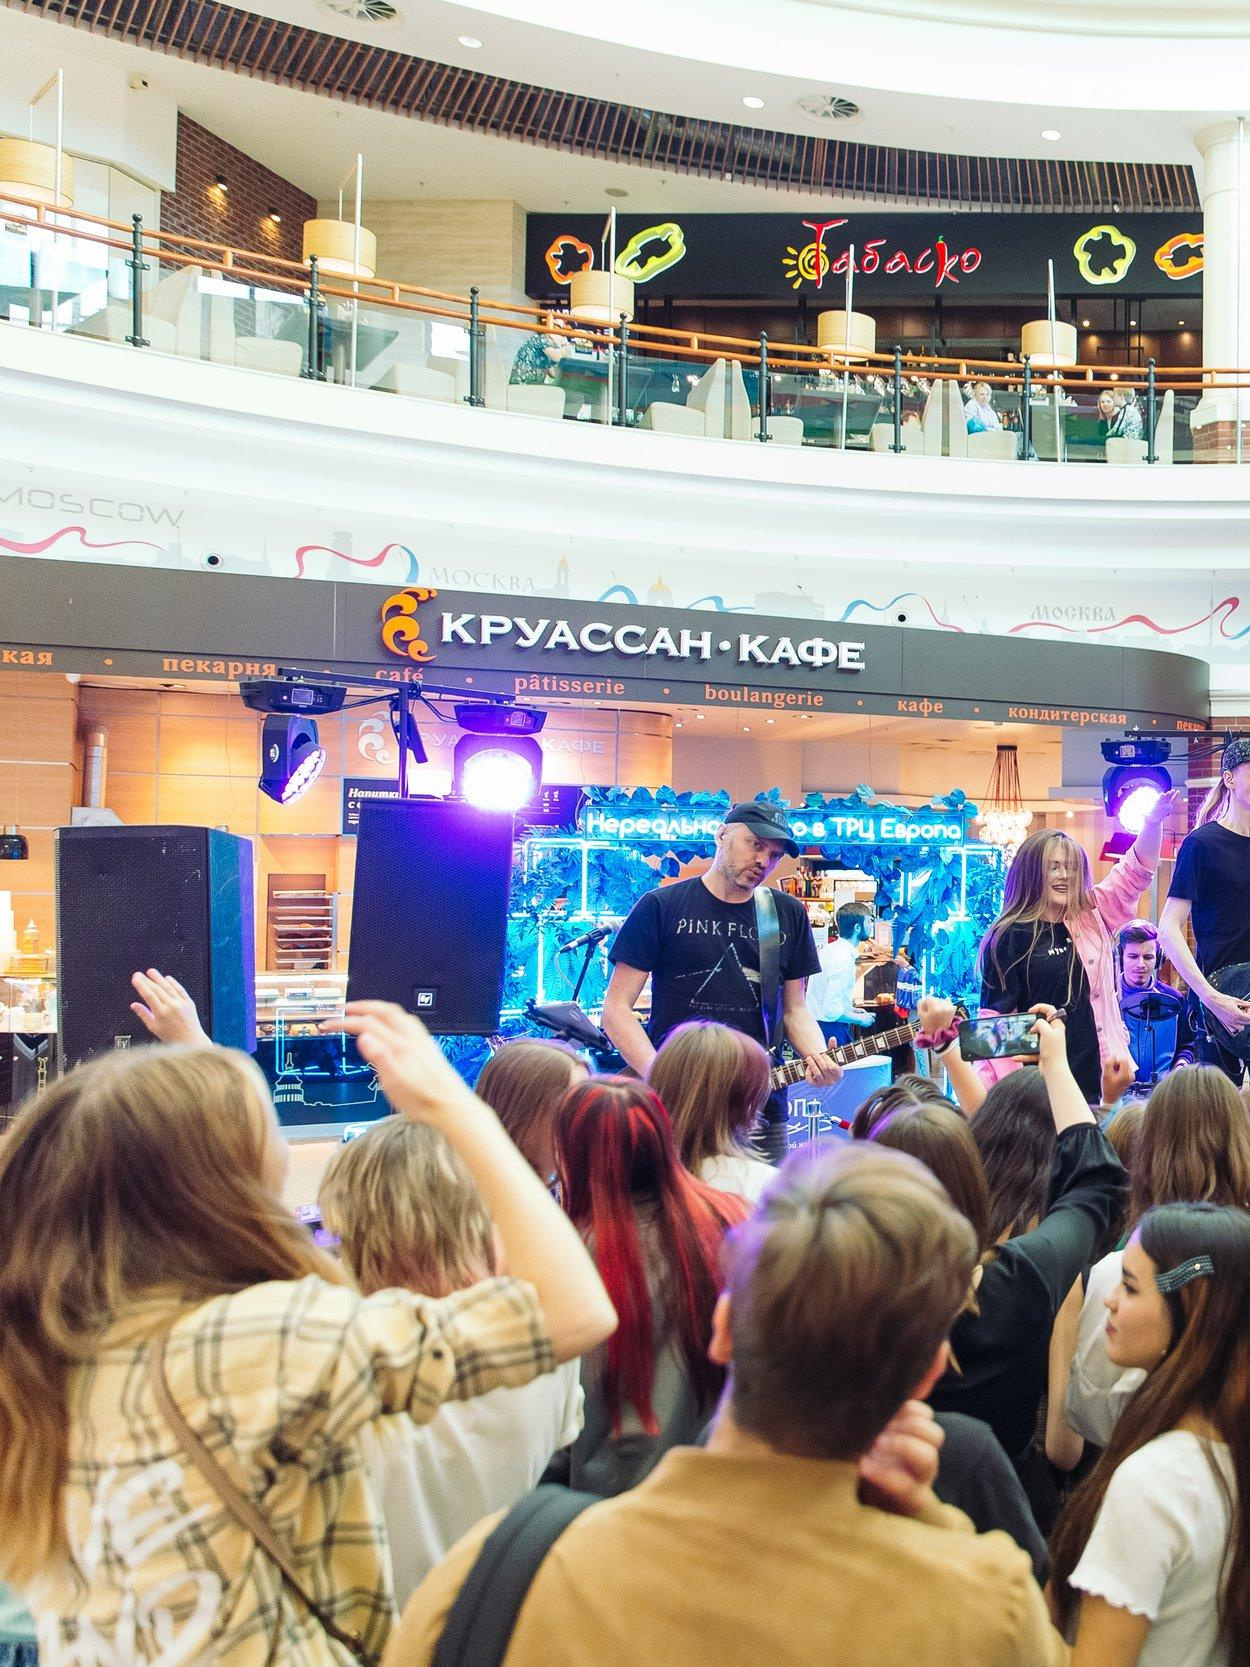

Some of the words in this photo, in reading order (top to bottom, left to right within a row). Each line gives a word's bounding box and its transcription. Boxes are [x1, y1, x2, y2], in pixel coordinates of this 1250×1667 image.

[802, 219, 982, 290] Табаско
[429, 567, 535, 593] МОСКВА
[440, 611, 712, 660] КРУАССАН
[737, 633, 867, 672] КАФЕ
[162, 656, 277, 680] пекарня
[375, 666, 425, 683] café
[514, 673, 626, 696] pâtisserie
[704, 684, 824, 708] boulangerie
[897, 697, 944, 718] кафе
[1008, 704, 1128, 726] кондитерская
[812, 821, 826, 838] в
[833, 817, 875, 842] ТРЦ
[880, 819, 962, 841] Европа
[676, 918, 722, 936] PINK
[728, 922, 787, 946] FLO
